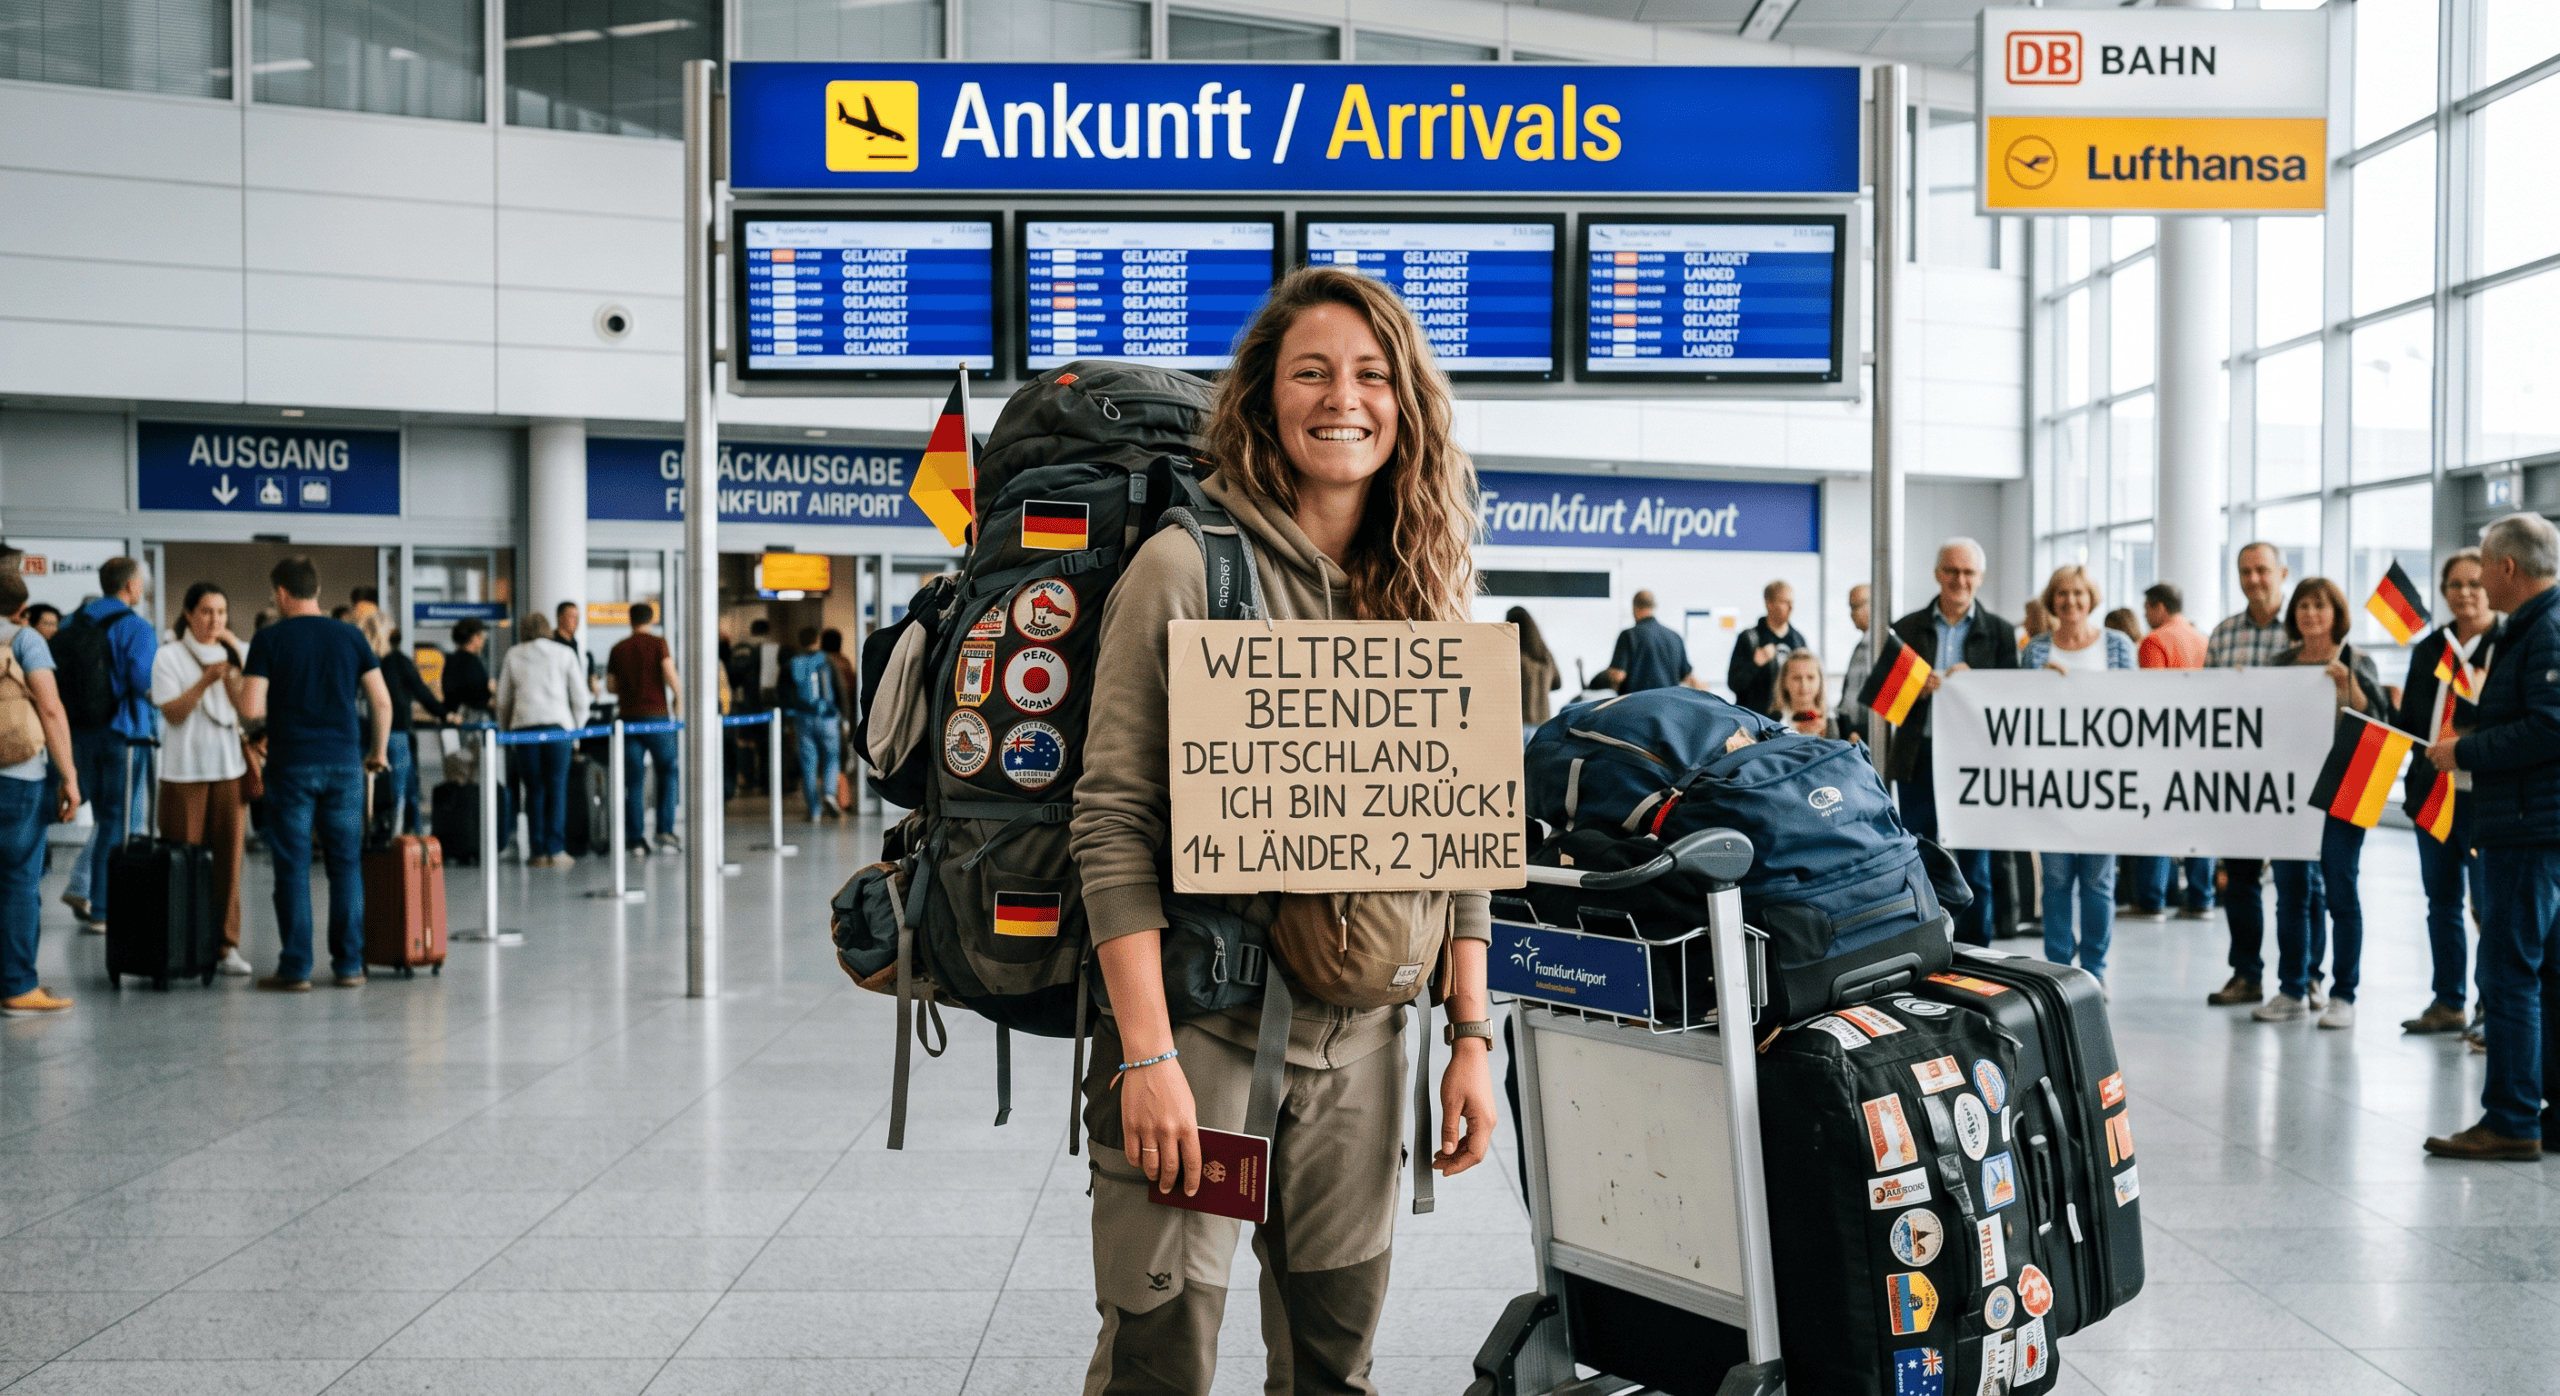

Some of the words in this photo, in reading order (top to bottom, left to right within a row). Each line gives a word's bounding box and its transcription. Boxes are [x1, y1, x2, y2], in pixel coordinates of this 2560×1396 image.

[2016, 40, 2073, 76] DB
[2101, 45, 2216, 76] BAHN
[941, 81, 1252, 160] Ankunft
[1272, 83, 1306, 164] /
[1326, 83, 1622, 162] Arrivals
[2088, 145, 2306, 182] Lufthansa
[842, 250, 907, 263] GELANDET
[1122, 250, 1188, 263] GELANDET
[1403, 251, 1469, 264] GELANDET
[842, 265, 907, 278] GELANDET
[1122, 266, 1188, 278] GELANDET
[1403, 266, 1469, 280] GELANDET
[1683, 267, 1735, 280] LANDED
[842, 280, 908, 293] GELANDET
[1122, 281, 1188, 294] GELANDET
[1403, 282, 1469, 295] GELANDET
[843, 296, 908, 308] GELANDET
[1122, 296, 1188, 309] GELANDET
[843, 311, 908, 324] GELANDET
[1122, 312, 1188, 324] GELANDET
[844, 326, 908, 340] GELANDET
[1122, 327, 1188, 340] GELANDET
[844, 342, 908, 354] GELANDET
[1122, 342, 1188, 356] GELANDET
[1682, 344, 1734, 358] LANDED
[189, 433, 350, 472] AUSGANG
[660, 445, 904, 487] GÄCKAUSGABE
[666, 487, 802, 516] FNKFURT
[807, 492, 904, 518] AIRPORT
[1480, 491, 1627, 535] Frankfurt
[1628, 497, 1739, 546] Airport
[1022, 650, 1056, 664] PERU
[1200, 636, 1463, 680] WELTREISE
[1015, 696, 1053, 710] JAPAN
[1984, 707, 2263, 749] WILLKOMMEN
[1181, 740, 1458, 778] DEUTSCHLAND,
[1221, 785, 1272, 820] ICH
[1288, 784, 1346, 819] BIN
[1362, 779, 1517, 819] ZURÜCK!
[1959, 767, 2151, 819] ZUHAUSE,
[2163, 771, 2296, 816] ANNA!
[1182, 834, 1226, 874] 14
[1238, 829, 1381, 877] LÄNDER,
[1389, 831, 1412, 871] 2
[1419, 832, 1521, 880] JAHRE
[1535, 961, 1575, 981] Frankfurt
[1575, 967, 1607, 987] Airport
